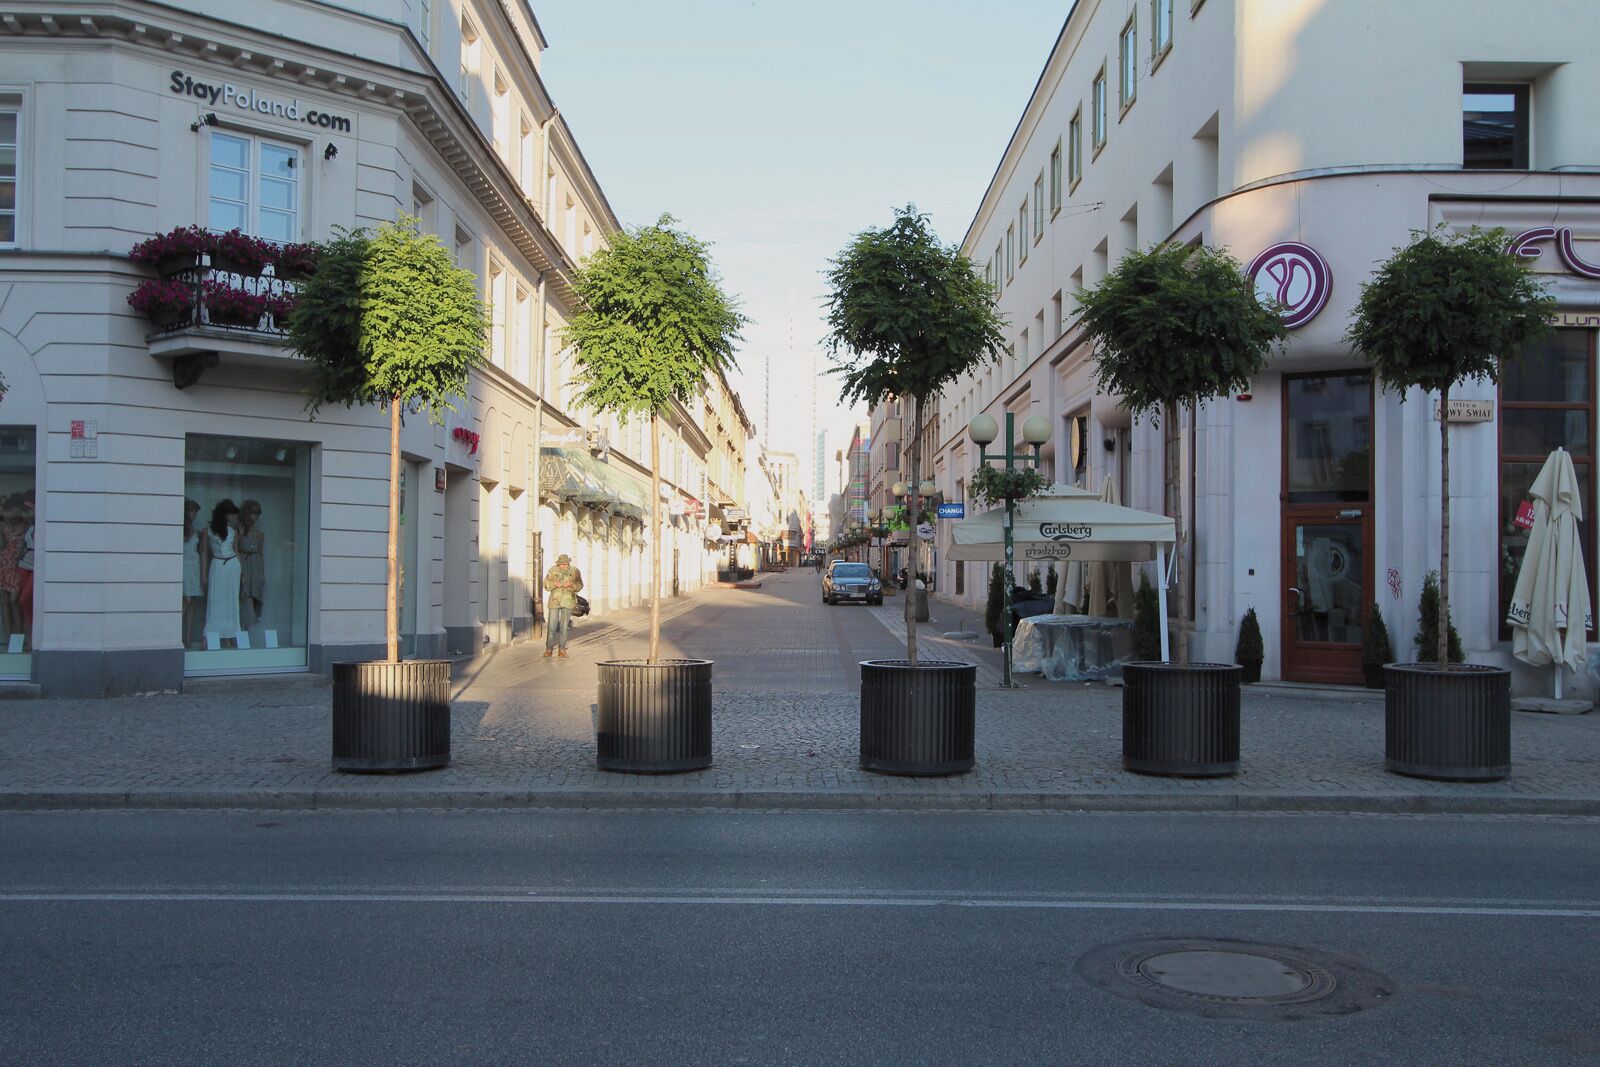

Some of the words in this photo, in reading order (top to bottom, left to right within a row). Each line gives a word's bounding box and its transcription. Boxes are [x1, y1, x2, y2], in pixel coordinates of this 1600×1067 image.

[170, 70, 351, 132] StayPoland.com
[938, 507, 964, 515] CHANGE
[1039, 522, 1092, 539] Carlsberg
